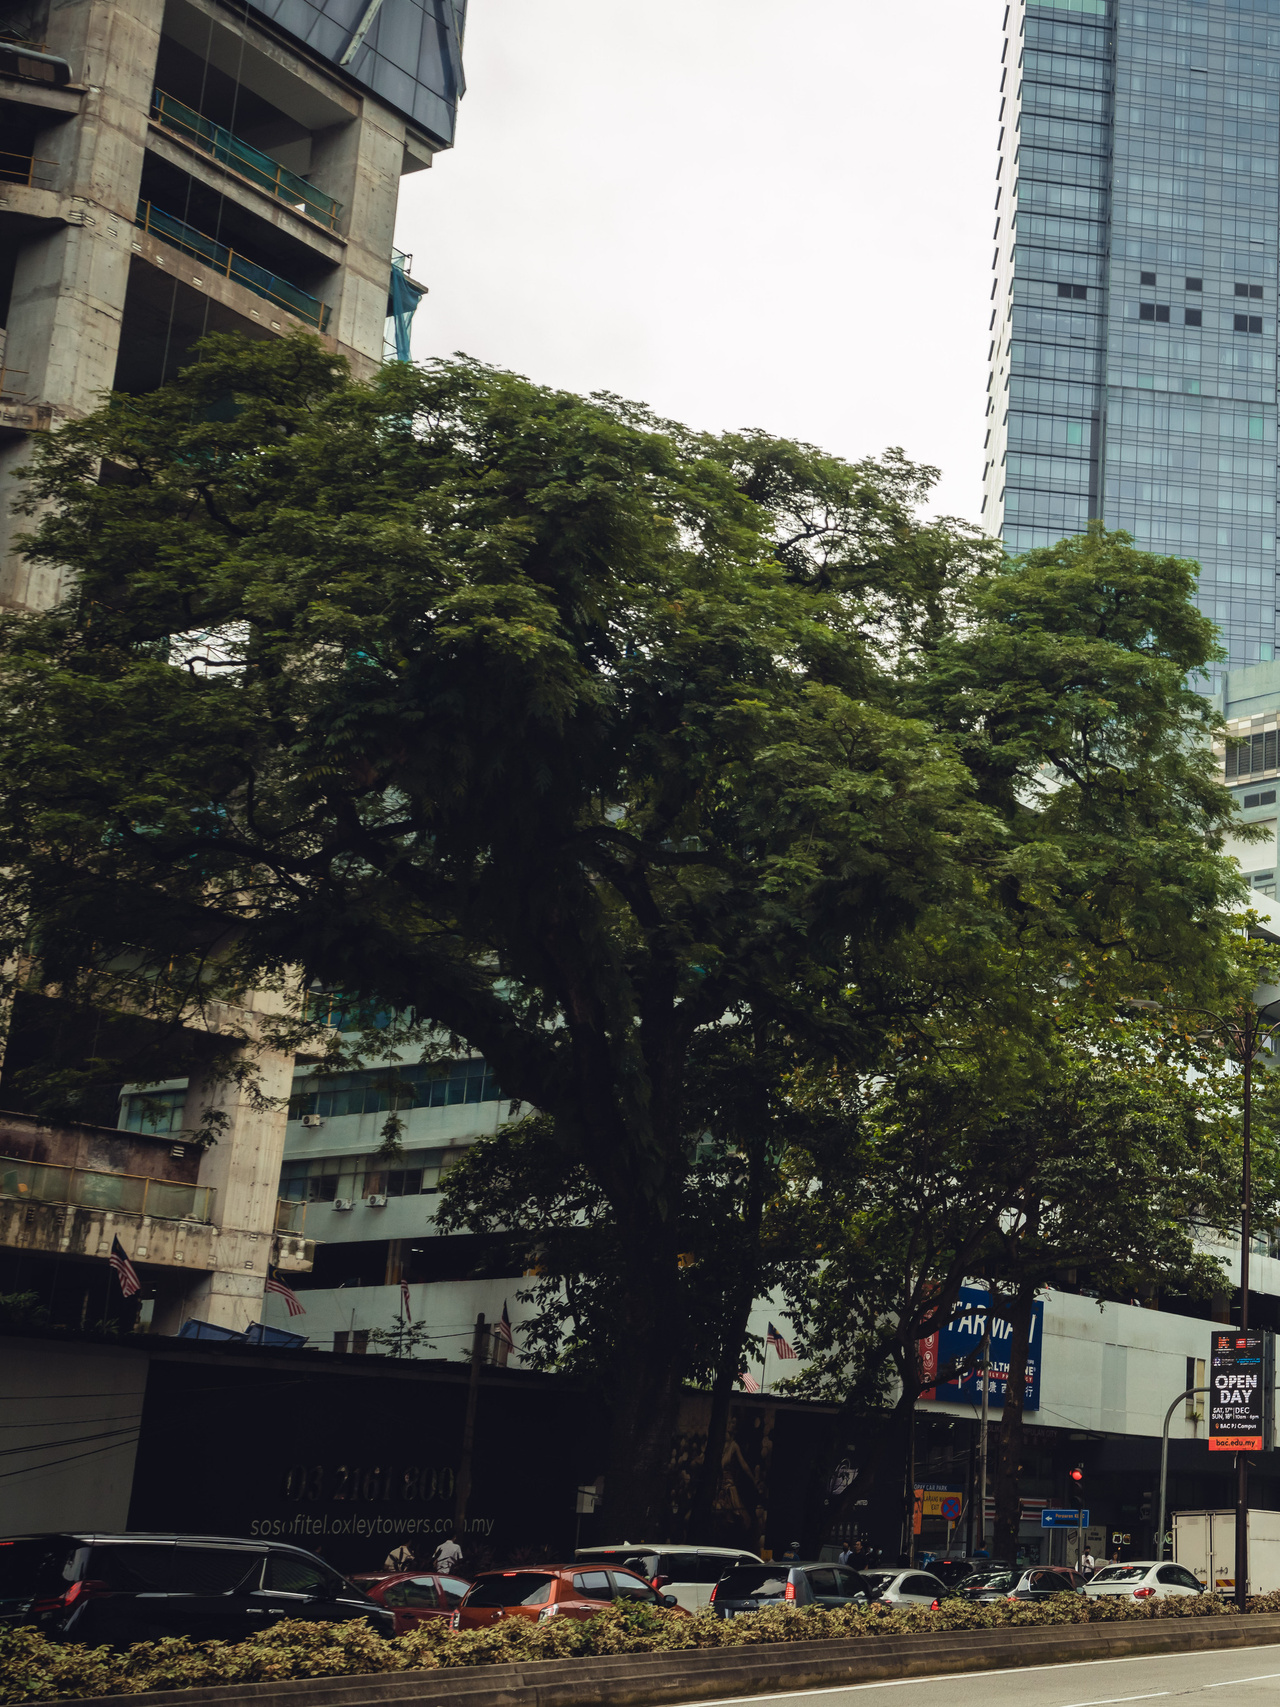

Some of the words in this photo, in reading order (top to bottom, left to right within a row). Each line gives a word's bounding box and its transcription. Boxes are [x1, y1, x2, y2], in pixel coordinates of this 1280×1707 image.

[948, 1301, 1036, 1344] FARMAI
[1215, 1374, 1258, 1390] OPEN
[1220, 1389, 1252, 1404] DAY
[1235, 1406, 1250, 1414] DEC
[1237, 1423, 1257, 1431] Campus
[1216, 1439, 1256, 1448] bac.edu.my
